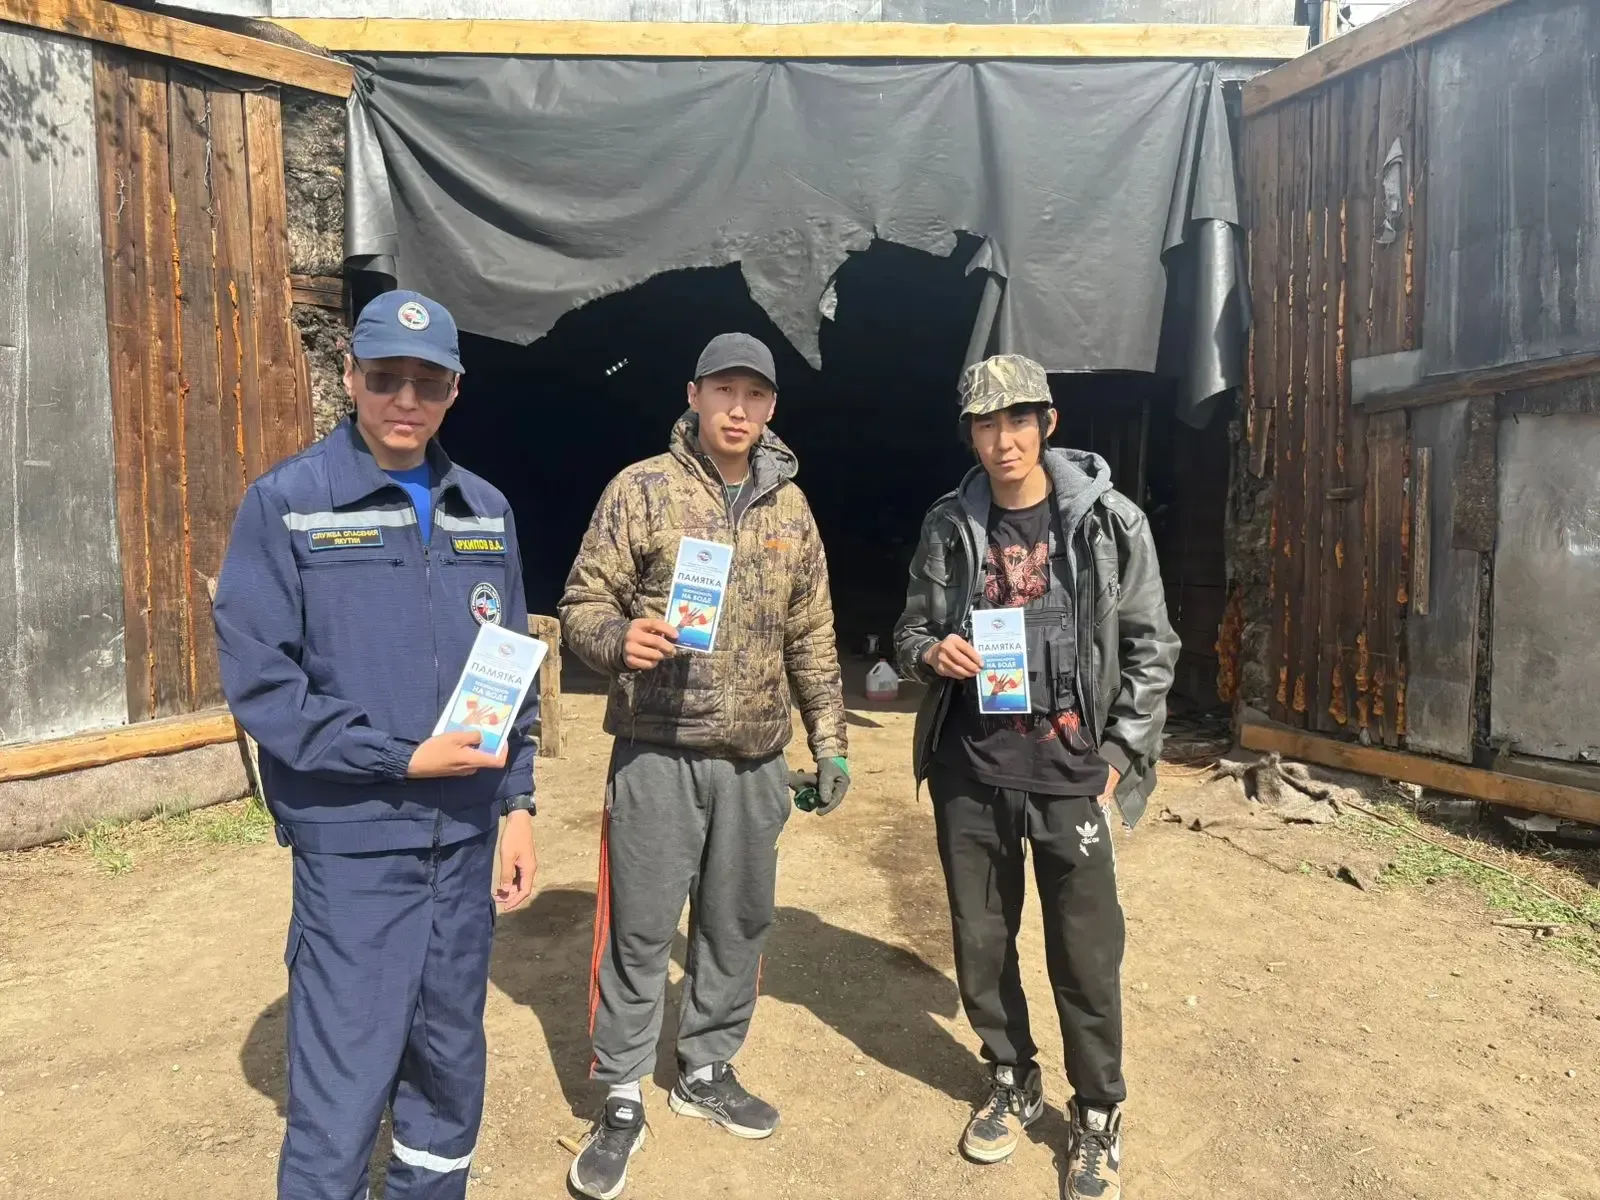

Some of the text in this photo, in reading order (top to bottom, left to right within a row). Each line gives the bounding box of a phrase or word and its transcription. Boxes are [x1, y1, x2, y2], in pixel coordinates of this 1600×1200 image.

[312, 529, 379, 540] СЛУЖБА СПАСЕНИЯ
[334, 537, 361, 545] ЯКУТИИ
[677, 572, 722, 588] ПАМЯТКА
[978, 642, 1022, 652] ПАМЯТКА
[471, 661, 523, 685] ПАМЯТКА
